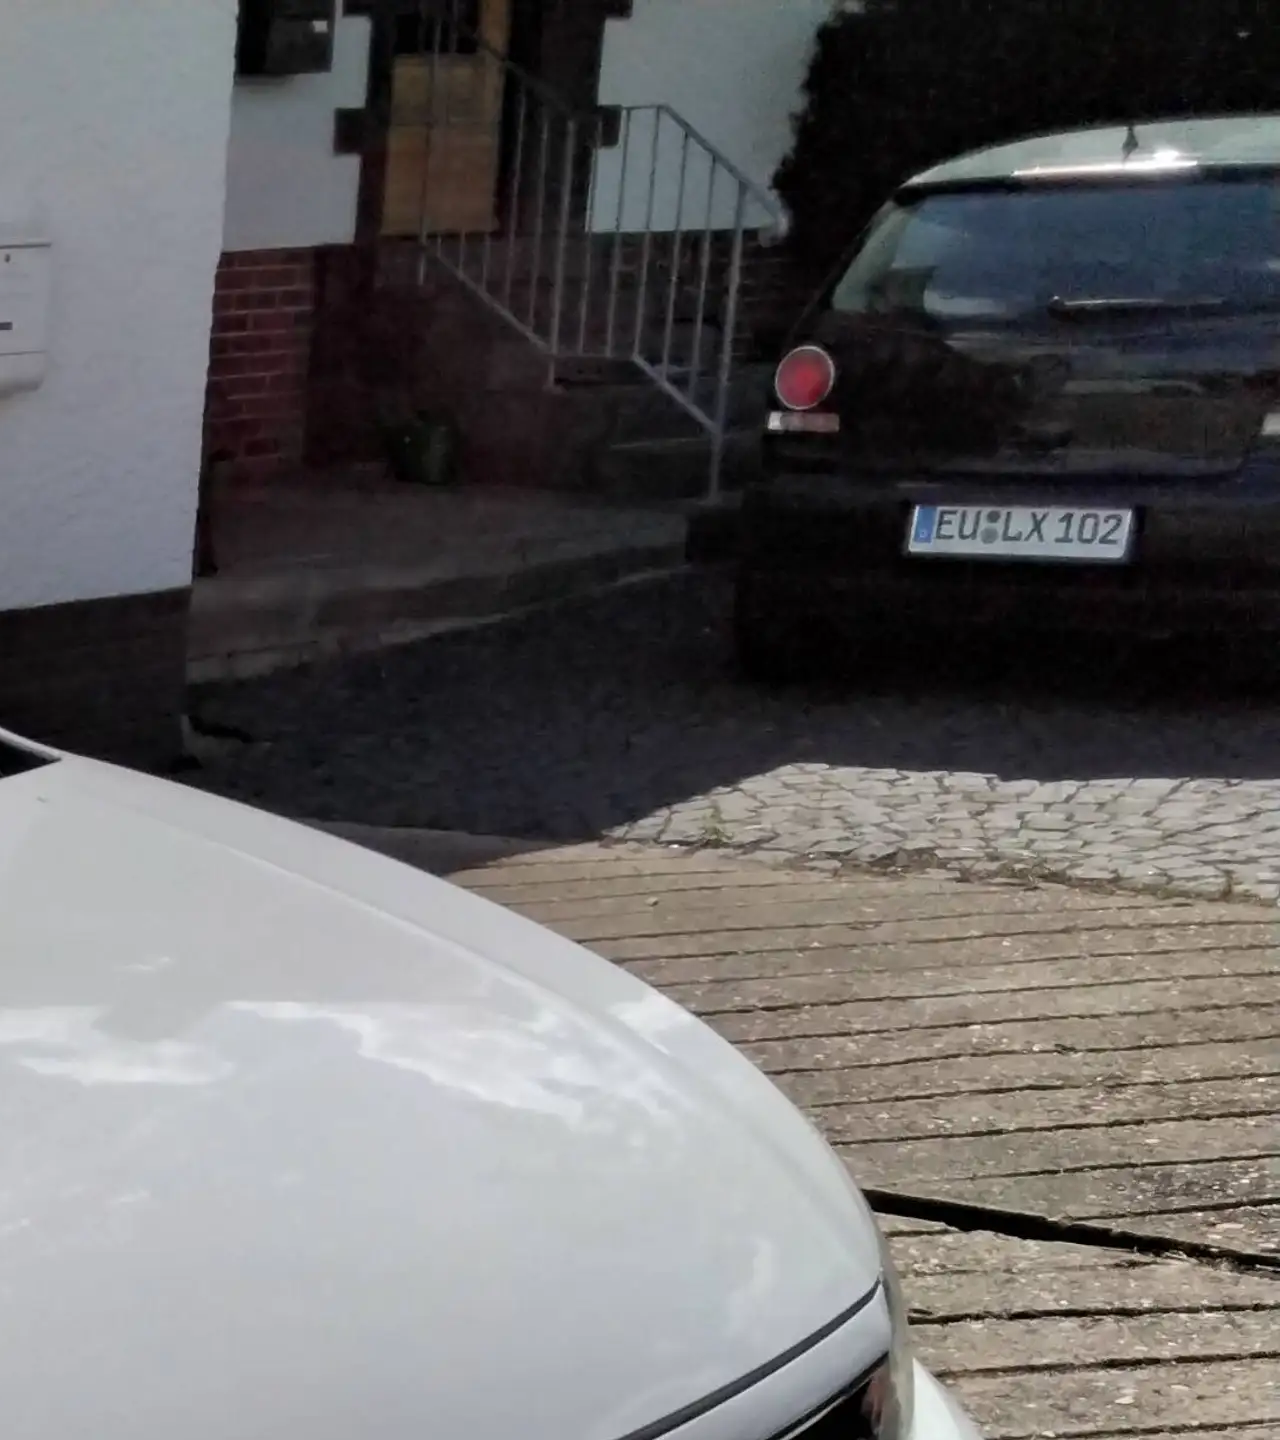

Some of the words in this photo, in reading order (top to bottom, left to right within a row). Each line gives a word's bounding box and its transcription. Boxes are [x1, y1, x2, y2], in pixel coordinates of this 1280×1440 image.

[936, 510, 981, 540] EU
[1002, 511, 1049, 542] LX
[1054, 513, 1124, 545] 102
